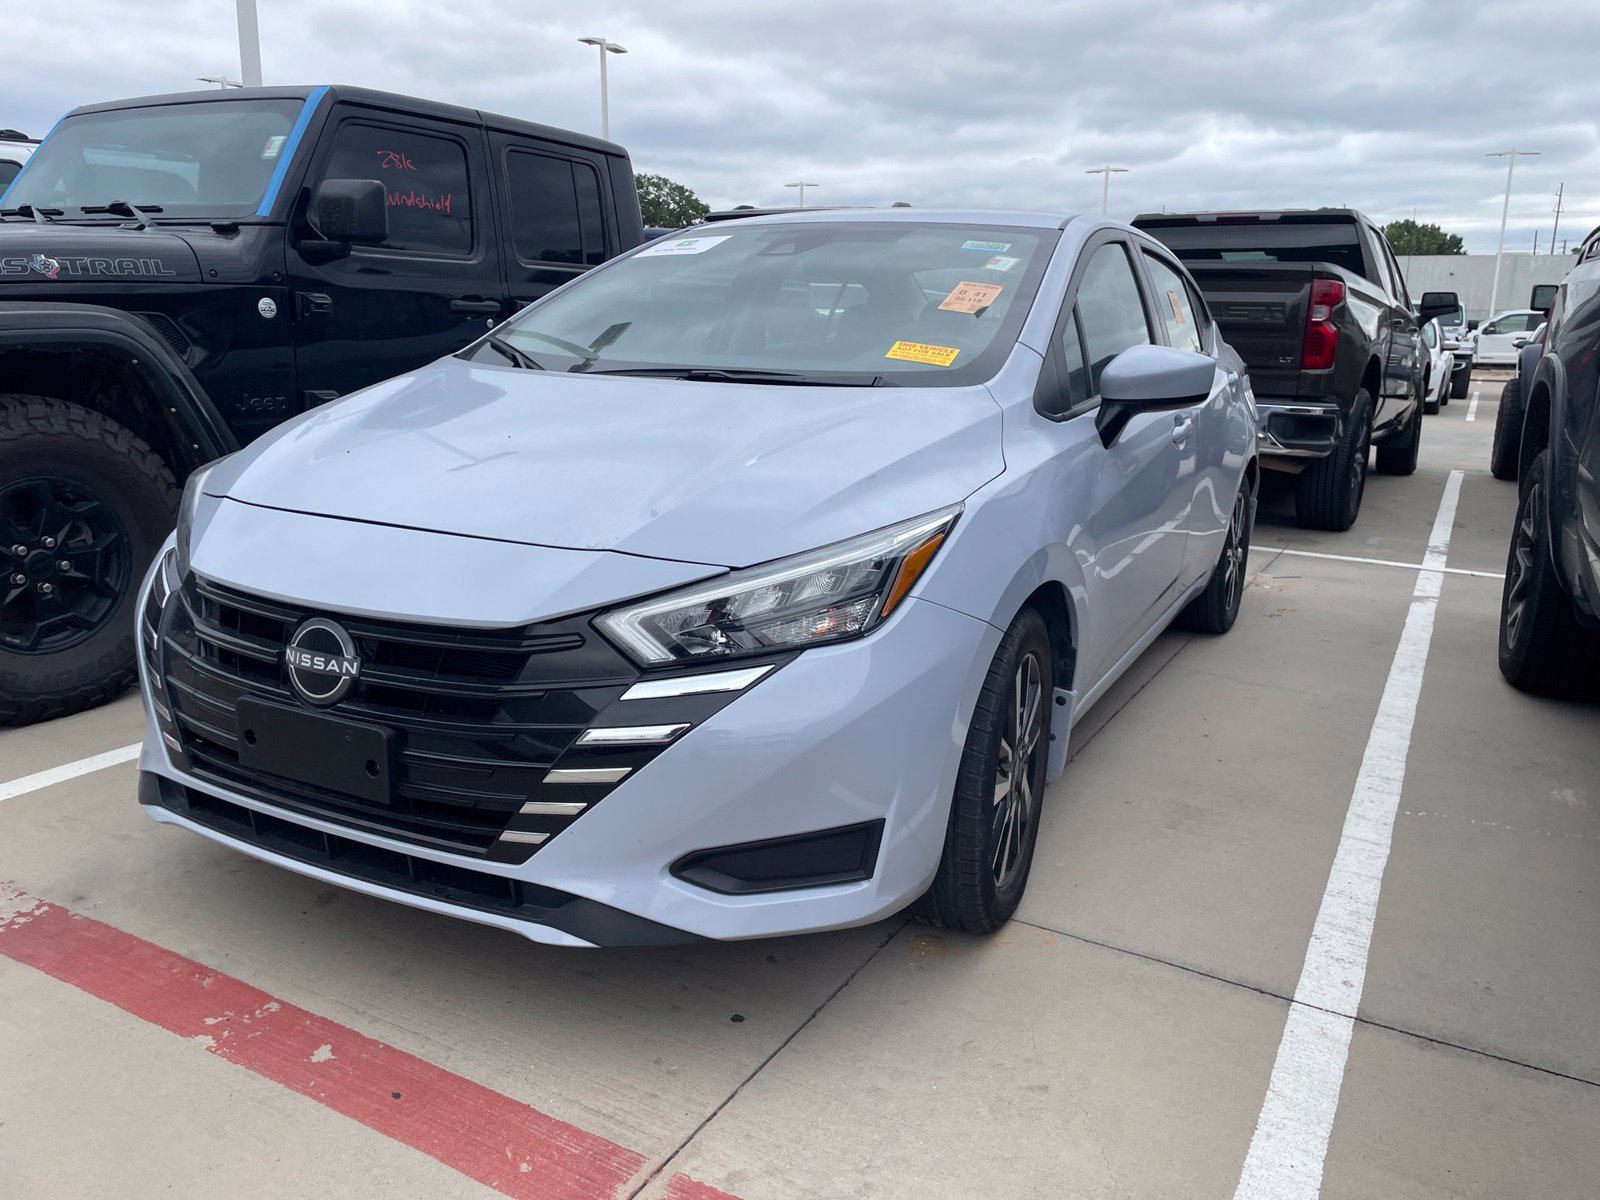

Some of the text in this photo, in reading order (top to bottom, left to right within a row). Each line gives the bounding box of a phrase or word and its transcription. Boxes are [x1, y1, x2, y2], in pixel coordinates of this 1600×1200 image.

[55, 256, 176, 276] TRAIL
[919, 344, 957, 354] VEHICLE
[234, 393, 287, 414] Jeep
[285, 648, 357, 675] NISSAN
